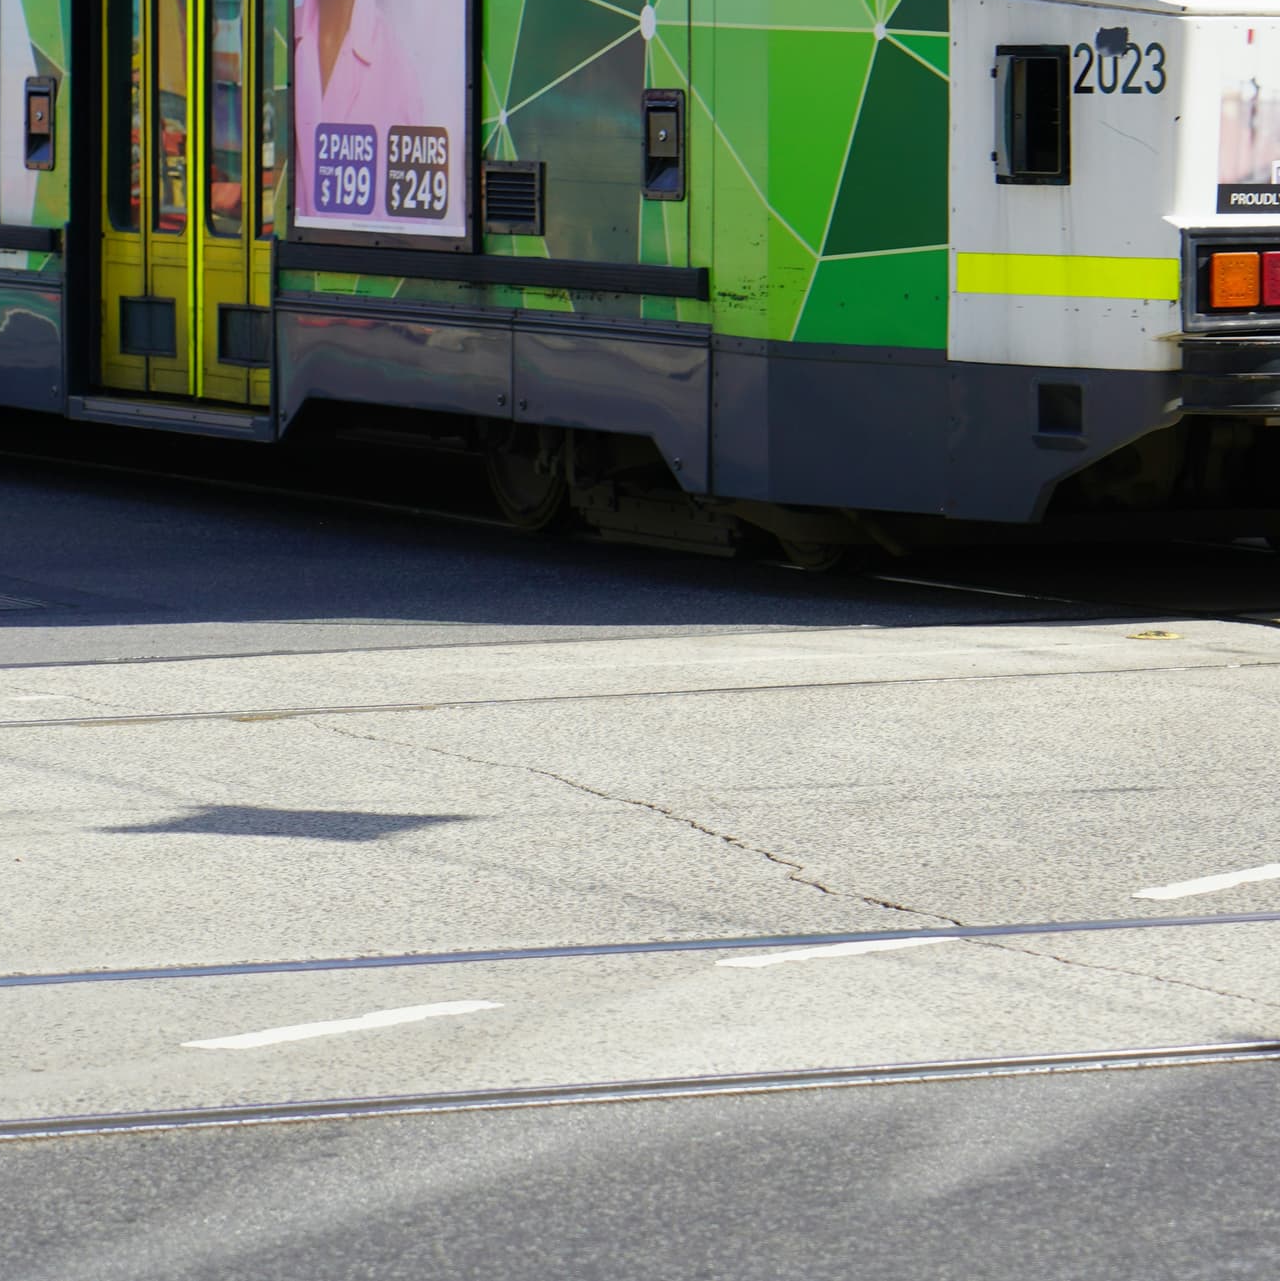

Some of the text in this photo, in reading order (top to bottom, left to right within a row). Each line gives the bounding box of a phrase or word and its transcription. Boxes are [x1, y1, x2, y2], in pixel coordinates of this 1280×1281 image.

[1073, 42, 1168, 95] 2023
[318, 133, 373, 162] 2 PAIRS
[389, 134, 447, 165] 3 PAIRS
